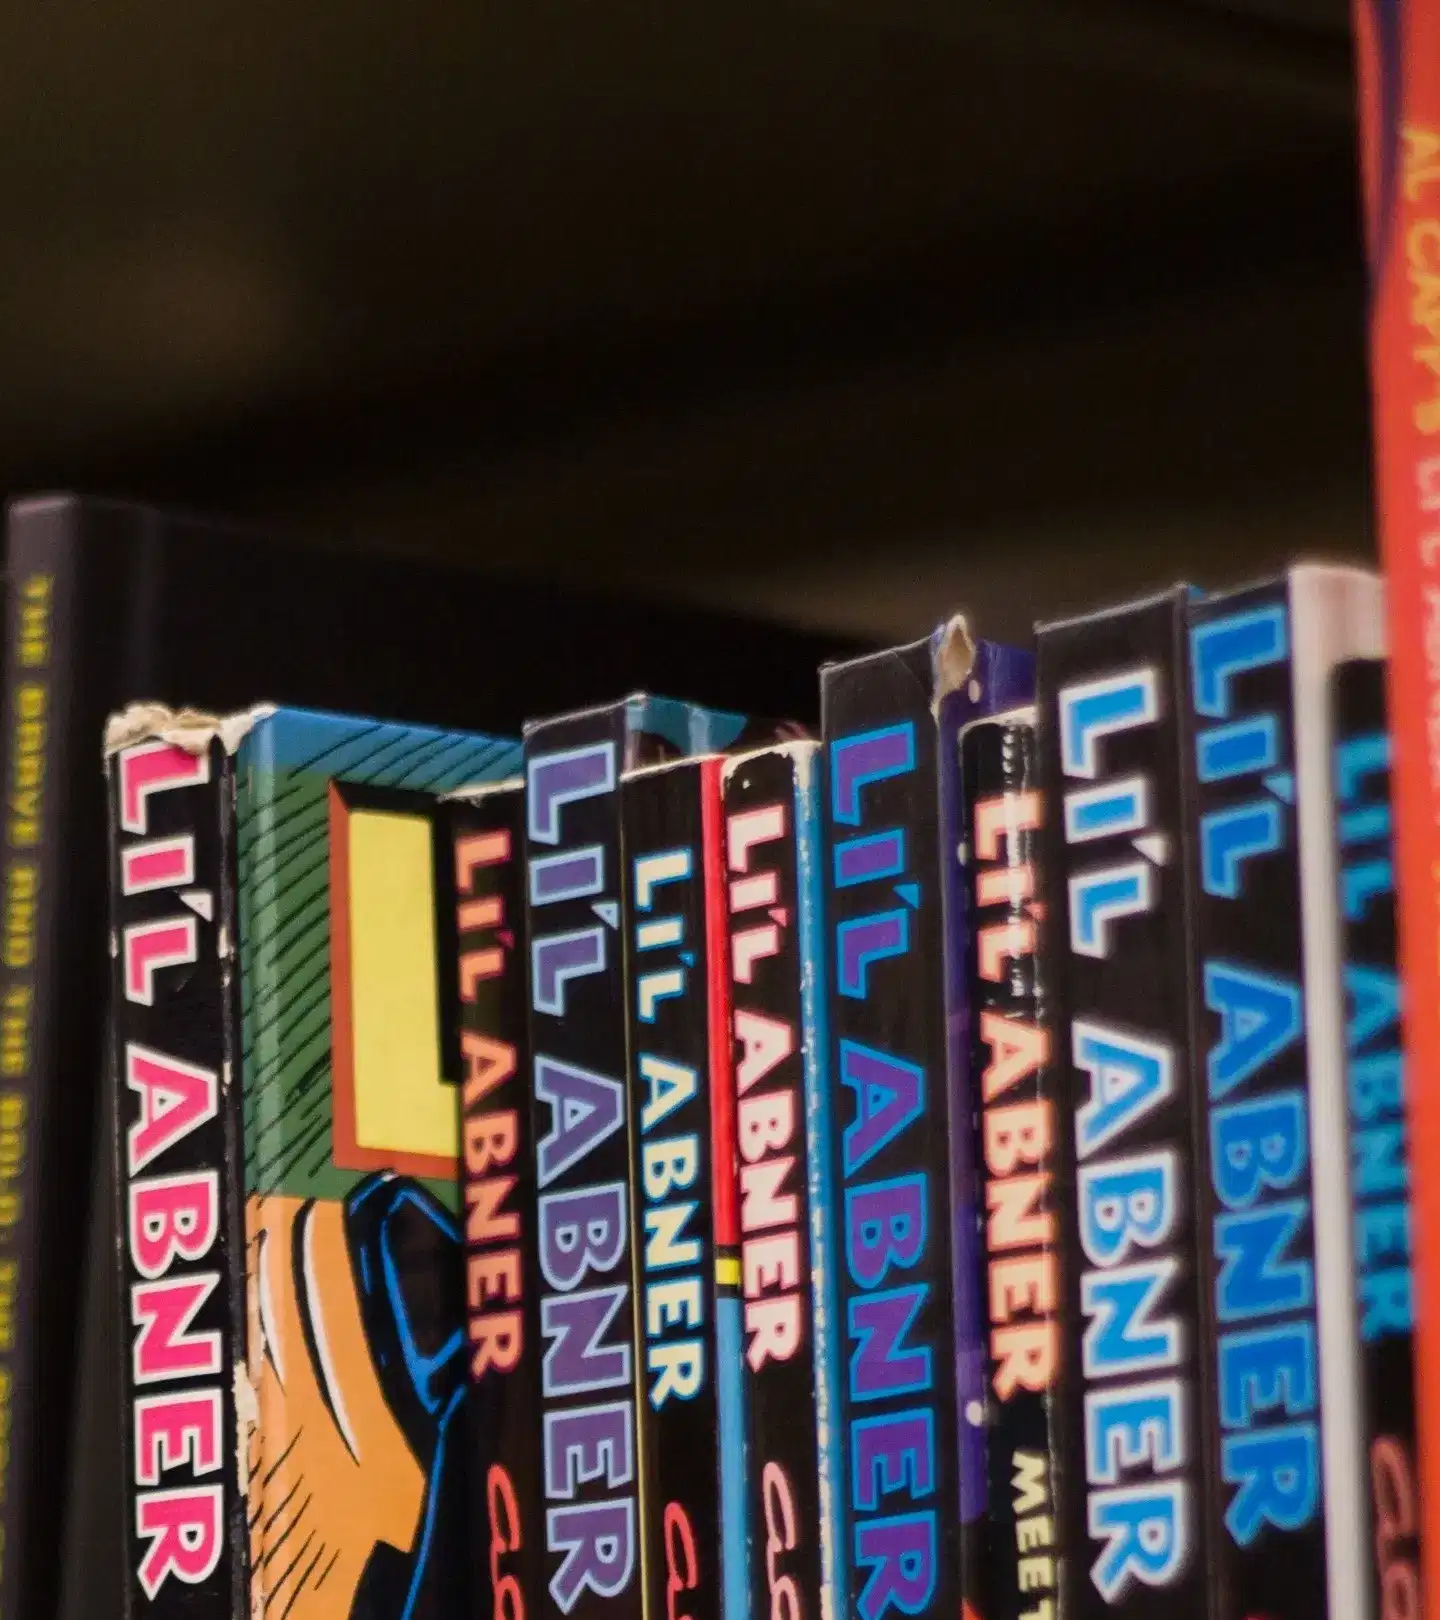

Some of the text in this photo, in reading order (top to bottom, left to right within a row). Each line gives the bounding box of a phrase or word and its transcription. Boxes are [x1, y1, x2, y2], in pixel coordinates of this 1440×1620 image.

[5, 682, 49, 847] BRAVE
[17, 575, 54, 667] THE
[0, 866, 42, 968] AND
[726, 803, 803, 1374] LI'L ABNER
[831, 721, 921, 1001] LI'L
[973, 792, 1048, 983] LI'L
[1189, 602, 1320, 1548] LI'L ABNER
[118, 738, 226, 1601] LI'L ABNER
[454, 828, 523, 1381] LI'L ABNER
[526, 740, 636, 1615] LI'L ABNER
[635, 848, 704, 1412] LI'L ABNER
[978, 1009, 1058, 1402] ABNER
[1058, 668, 1187, 1604] LI'L ABNER
[1344, 961, 1417, 1342] ABNER
